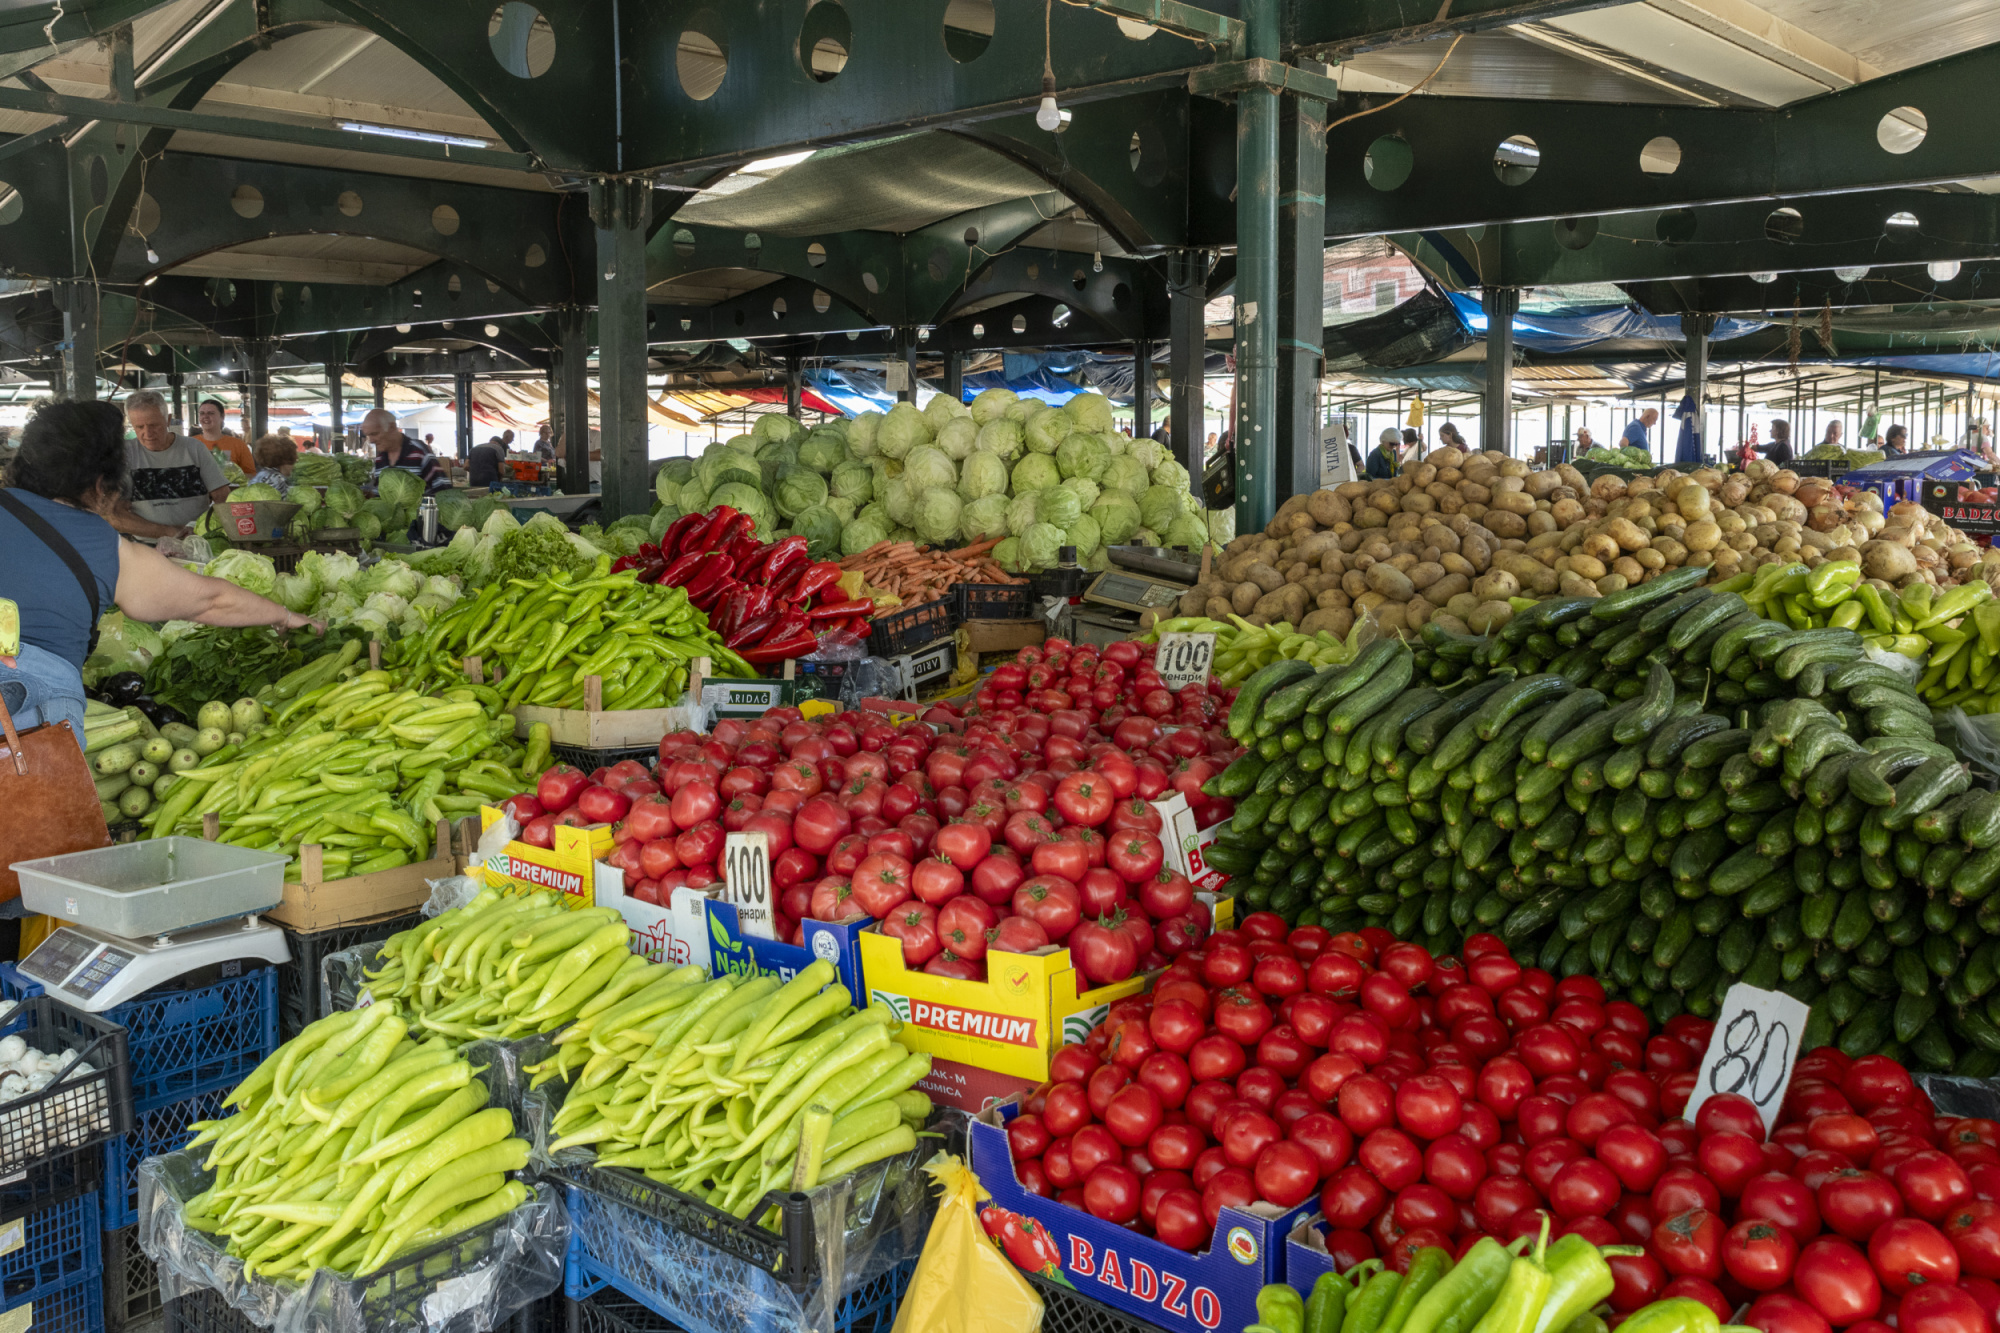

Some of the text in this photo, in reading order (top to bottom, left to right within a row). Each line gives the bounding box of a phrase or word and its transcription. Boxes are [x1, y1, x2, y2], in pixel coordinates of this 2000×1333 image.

[913, 658, 938, 674] ARID
[1161, 640, 1210, 672] 100
[1167, 673, 1202, 683] енари
[512, 859, 581, 894] PREMIUM
[727, 846, 765, 904] 100
[740, 908, 766, 923] енари
[915, 1003, 1031, 1044] PREMIUM
[917, 1027, 936, 1036] Healthy
[937, 1030, 949, 1038] food
[950, 1034, 967, 1042] makes
[1709, 1008, 1790, 1107] 80
[914, 1079, 962, 1098] RUMICA
[1067, 1233, 1222, 1329] BADZO
